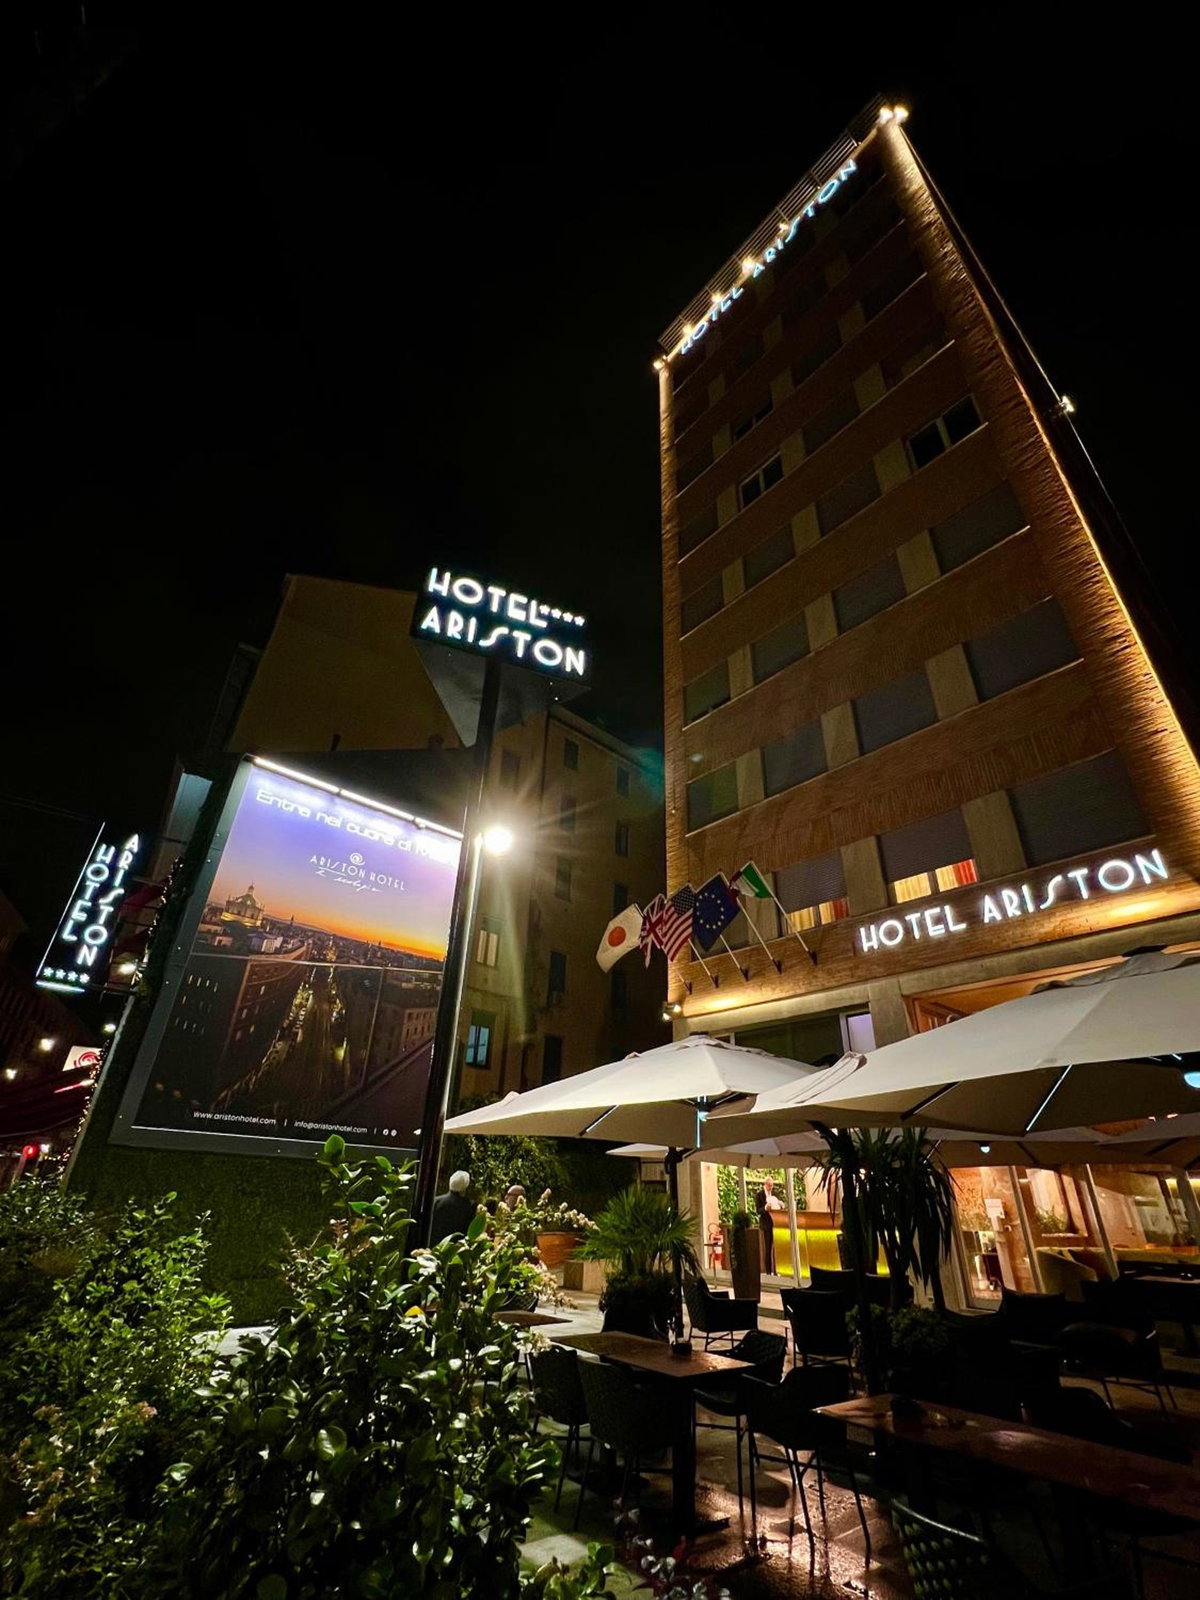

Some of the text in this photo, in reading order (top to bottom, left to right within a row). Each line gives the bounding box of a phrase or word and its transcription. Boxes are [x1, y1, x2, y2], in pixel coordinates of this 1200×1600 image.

[680, 159, 857, 355] HOTEL ARISTON
[428, 567, 548, 629] HOTEL
[420, 605, 586, 677] ARISTON
[316, 812, 342, 828] nel
[62, 843, 115, 941] HOTEL
[77, 833, 139, 966] ARISTON
[310, 855, 366, 878] ARISTON
[370, 872, 405, 891] HOTEL
[859, 848, 1168, 953] HOTEL ARISTON
[193, 1110, 368, 1134] www.aristonhotel.com info@aristonhotel.com
